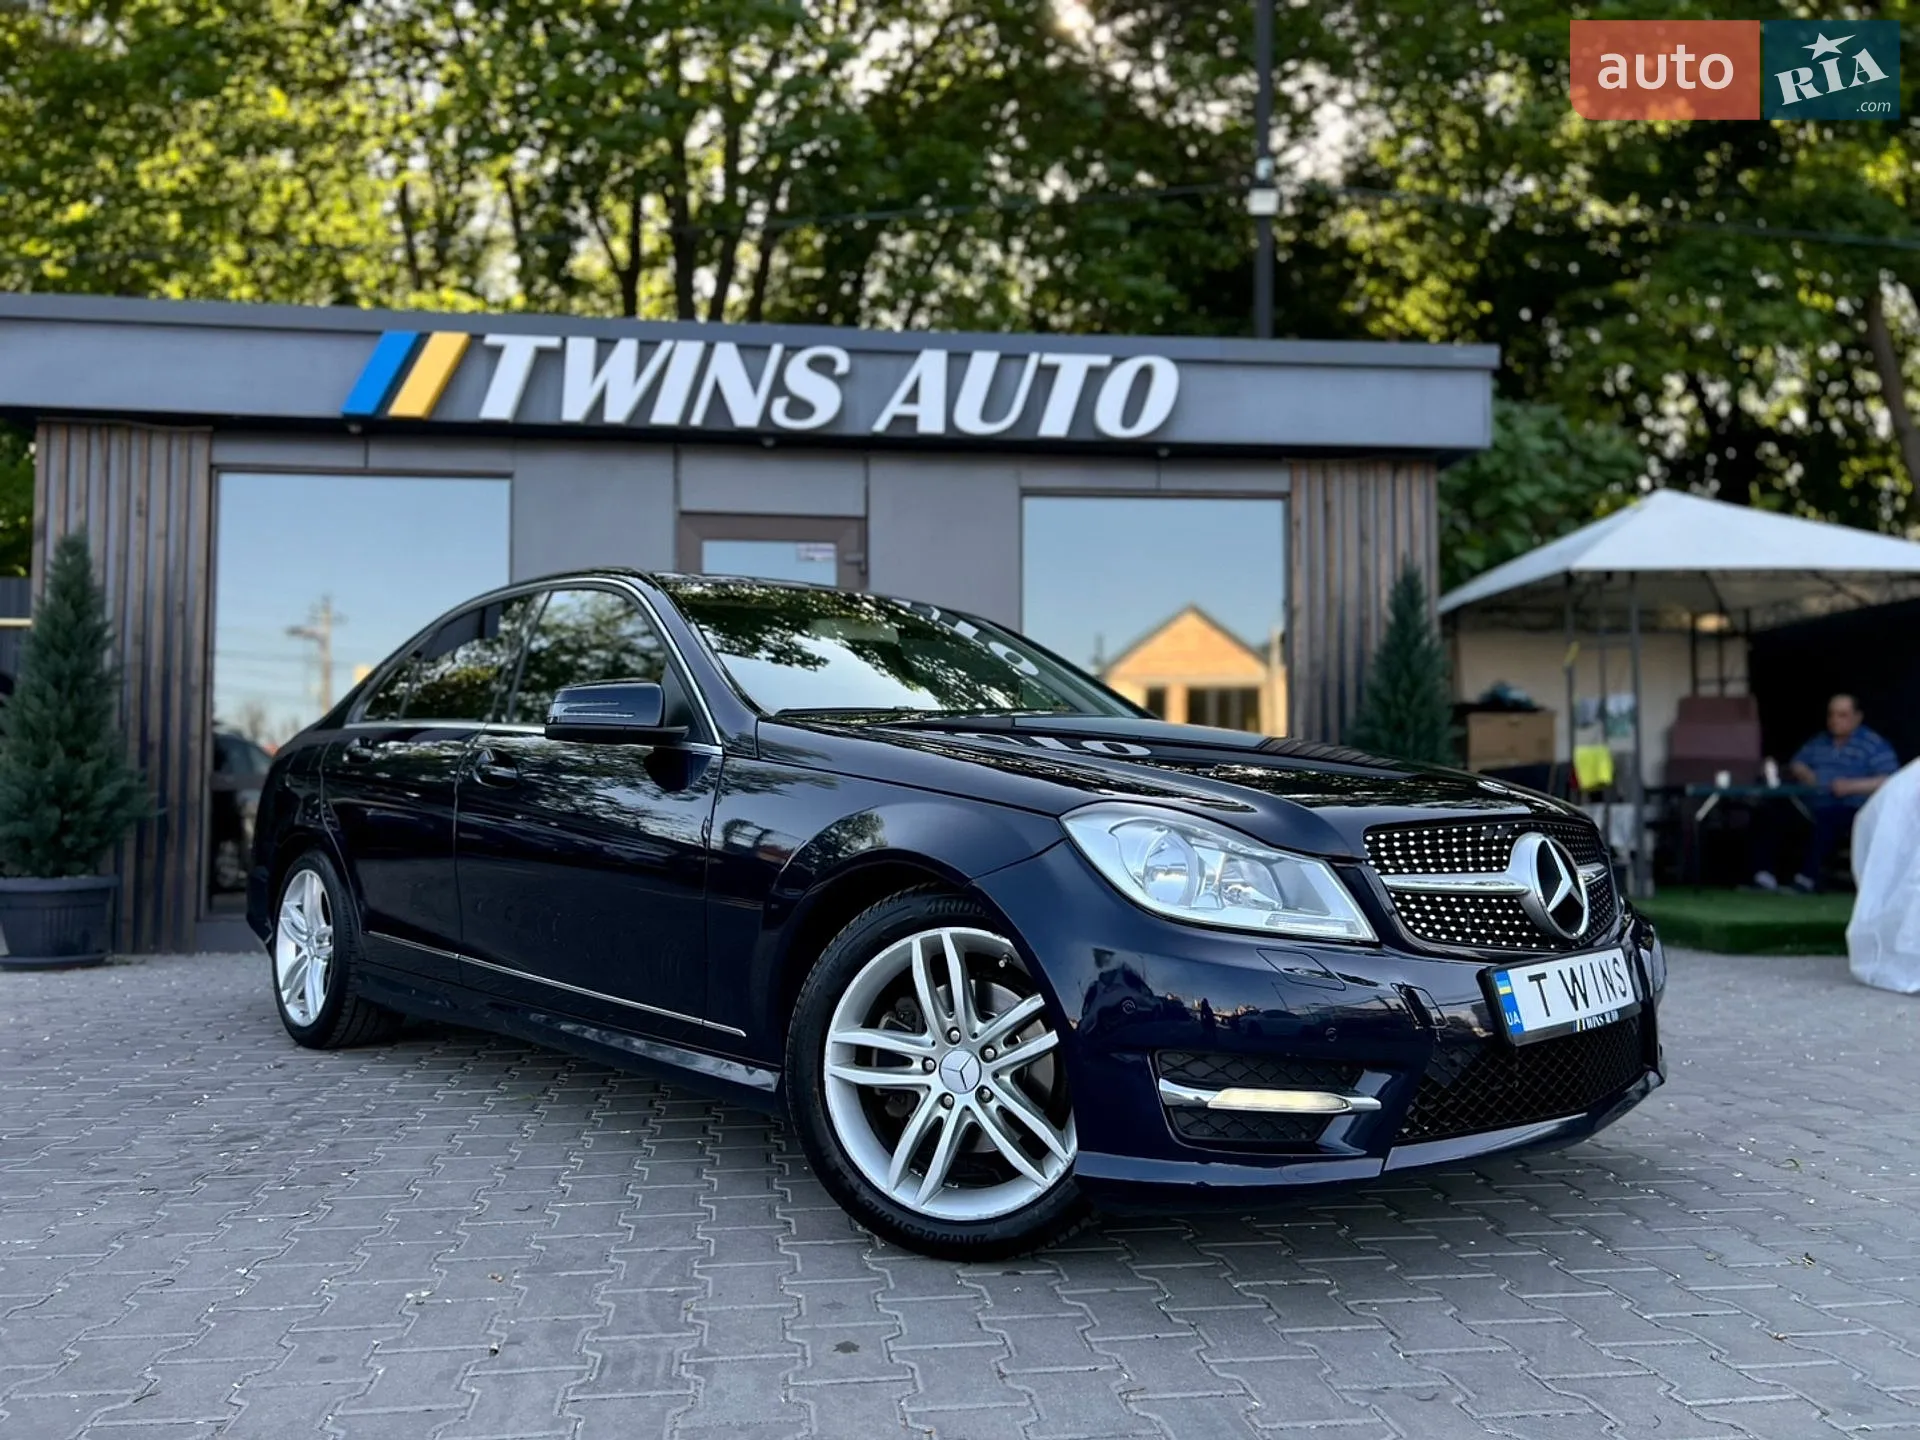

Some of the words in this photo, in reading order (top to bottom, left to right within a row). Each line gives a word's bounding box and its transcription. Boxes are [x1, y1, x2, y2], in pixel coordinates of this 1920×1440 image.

[479, 333, 850, 430] TWINS
[871, 349, 1180, 438] AUTO
[1505, 1011, 1522, 1026] UA
